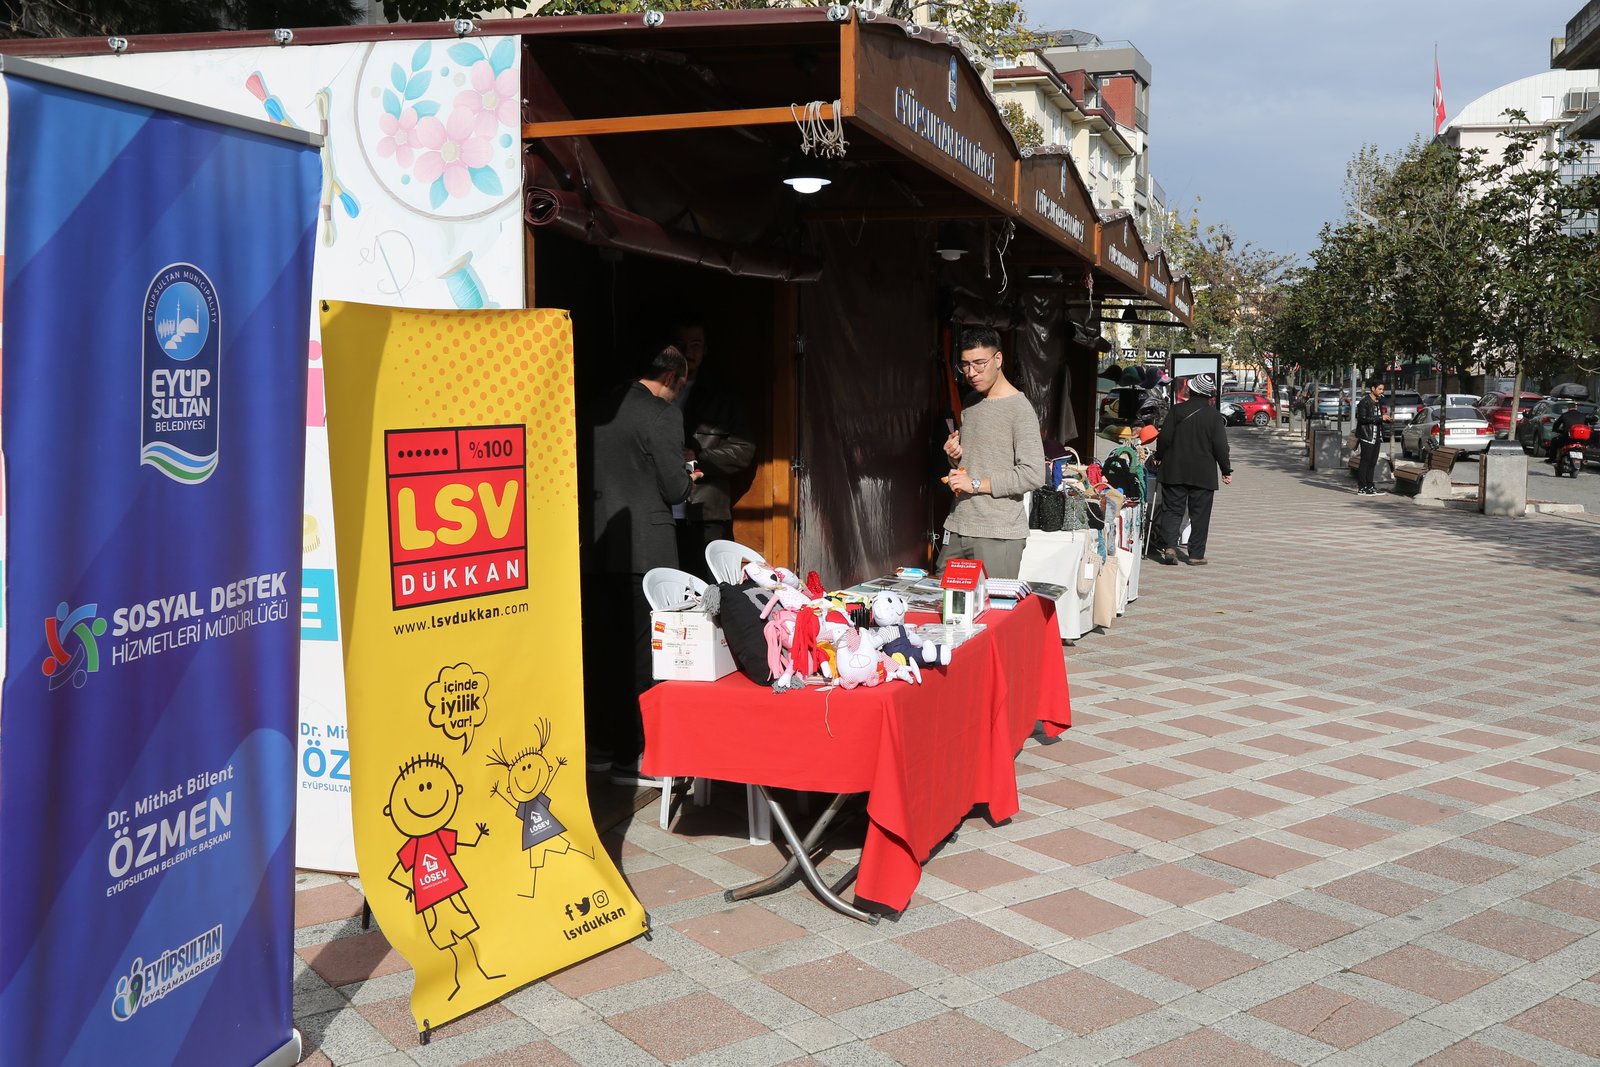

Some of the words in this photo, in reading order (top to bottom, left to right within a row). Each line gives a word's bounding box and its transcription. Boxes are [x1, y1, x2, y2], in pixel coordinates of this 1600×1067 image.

[183, 271, 217, 324] MUNICIPALITY
[151, 369, 211, 397] EYÜP
[151, 398, 211, 419] SULTAN
[155, 420, 206, 432] BELEDİYESİ
[469, 439, 513, 459] %100
[397, 480, 519, 551] LSV
[401, 559, 520, 596] DÜKKAN
[112, 592, 204, 637] SOSYAL
[210, 571, 287, 613] DESTEK
[393, 602, 529, 635] www.lsvdukkan.com
[112, 619, 201, 666] HİZMETLERİ
[204, 600, 289, 641] MÜDÜRLÜĞÜ
[443, 678, 479, 696] içinde
[440, 693, 480, 718] iyilik
[300, 722, 322, 737] Dr.
[449, 716, 472, 729] var!
[107, 811, 130, 830] Dr.
[135, 783, 183, 818] Mithat
[187, 764, 234, 795] Bülent
[107, 791, 233, 878] ÖZMEN
[530, 819, 550, 834] LÖSEV
[106, 864, 160, 898] EYÜPSULTAN
[161, 845, 197, 871] BELEDİYE
[198, 831, 232, 852] BAŞKANI
[419, 869, 447, 886] LÖSEV
[563, 905, 626, 941] lsvdukkan
[143, 926, 222, 993] EYÜPSULTAN
